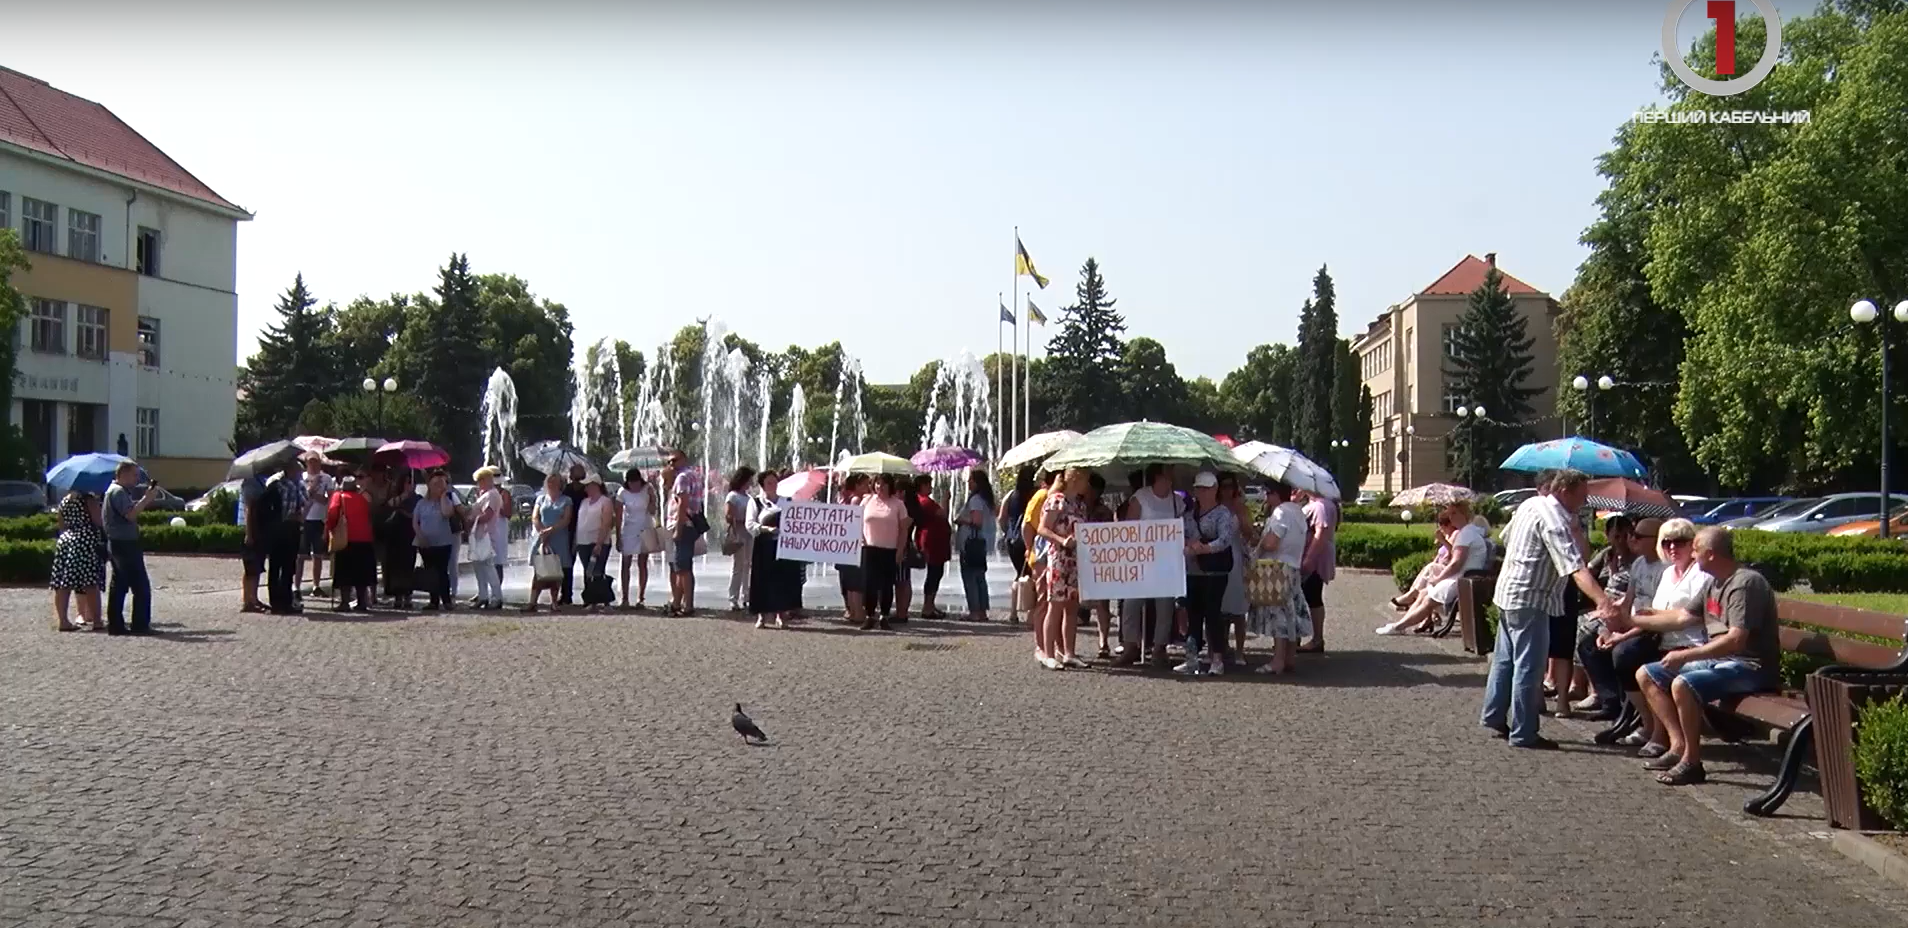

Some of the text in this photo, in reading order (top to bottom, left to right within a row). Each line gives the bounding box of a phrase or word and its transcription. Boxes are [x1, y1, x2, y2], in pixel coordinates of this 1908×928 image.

[783, 521, 847, 537] ЗБЕРЕЖІТЬ
[1081, 524, 1141, 545] ЗДОРОВІ
[780, 536, 860, 555] НАШУ ШКОЛУ!
[1089, 545, 1155, 564] ЗДОРОВА
[1093, 564, 1145, 583] НАЦІЯ!
